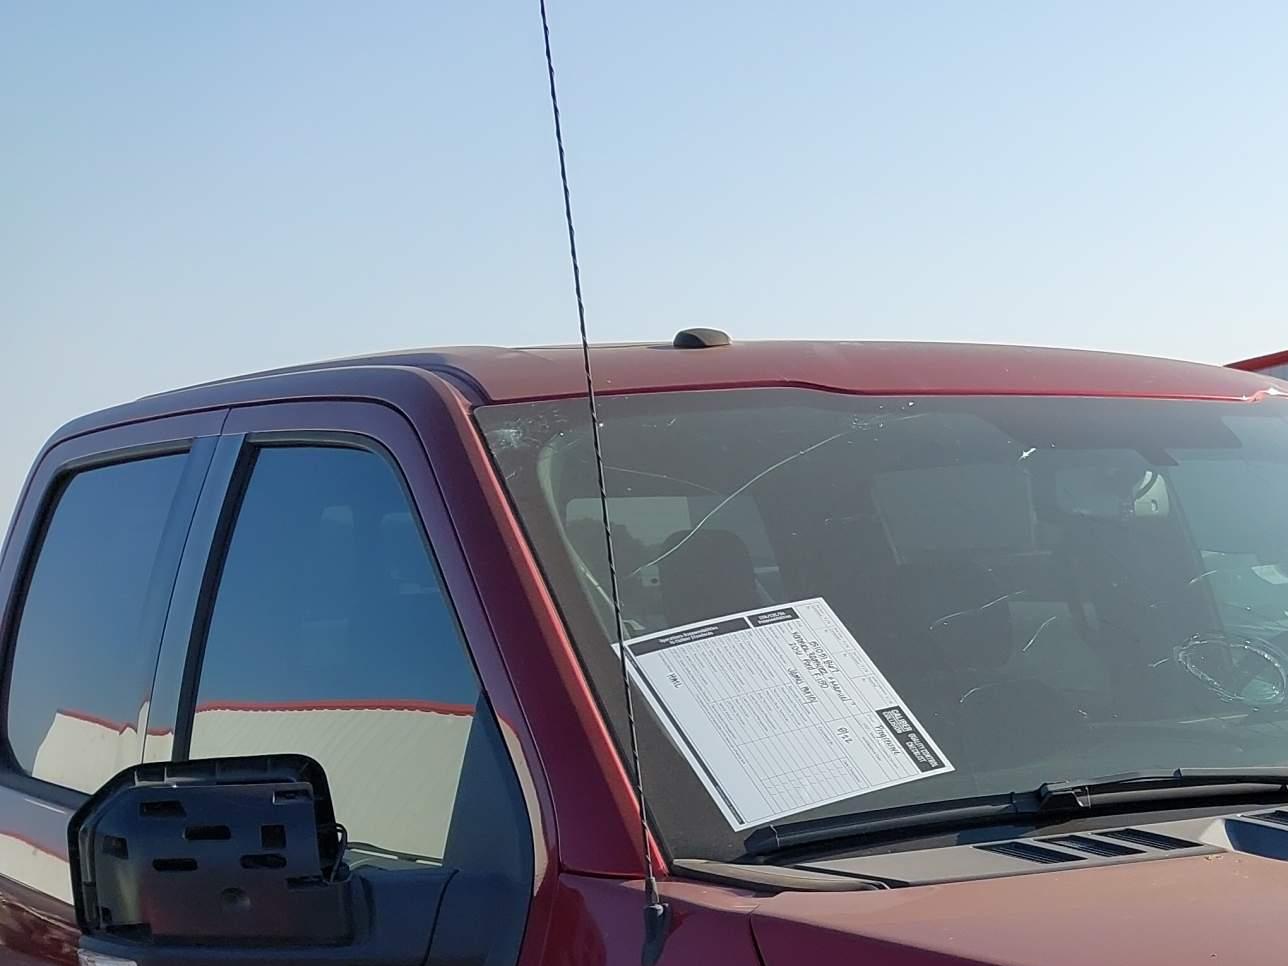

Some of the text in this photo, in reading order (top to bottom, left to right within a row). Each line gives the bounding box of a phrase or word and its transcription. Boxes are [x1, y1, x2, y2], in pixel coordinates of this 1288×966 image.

[882, 711, 903, 734] COLLISION
[890, 709, 913, 733] CALIBER
[907, 732, 939, 768] QUALITY CONTROL
